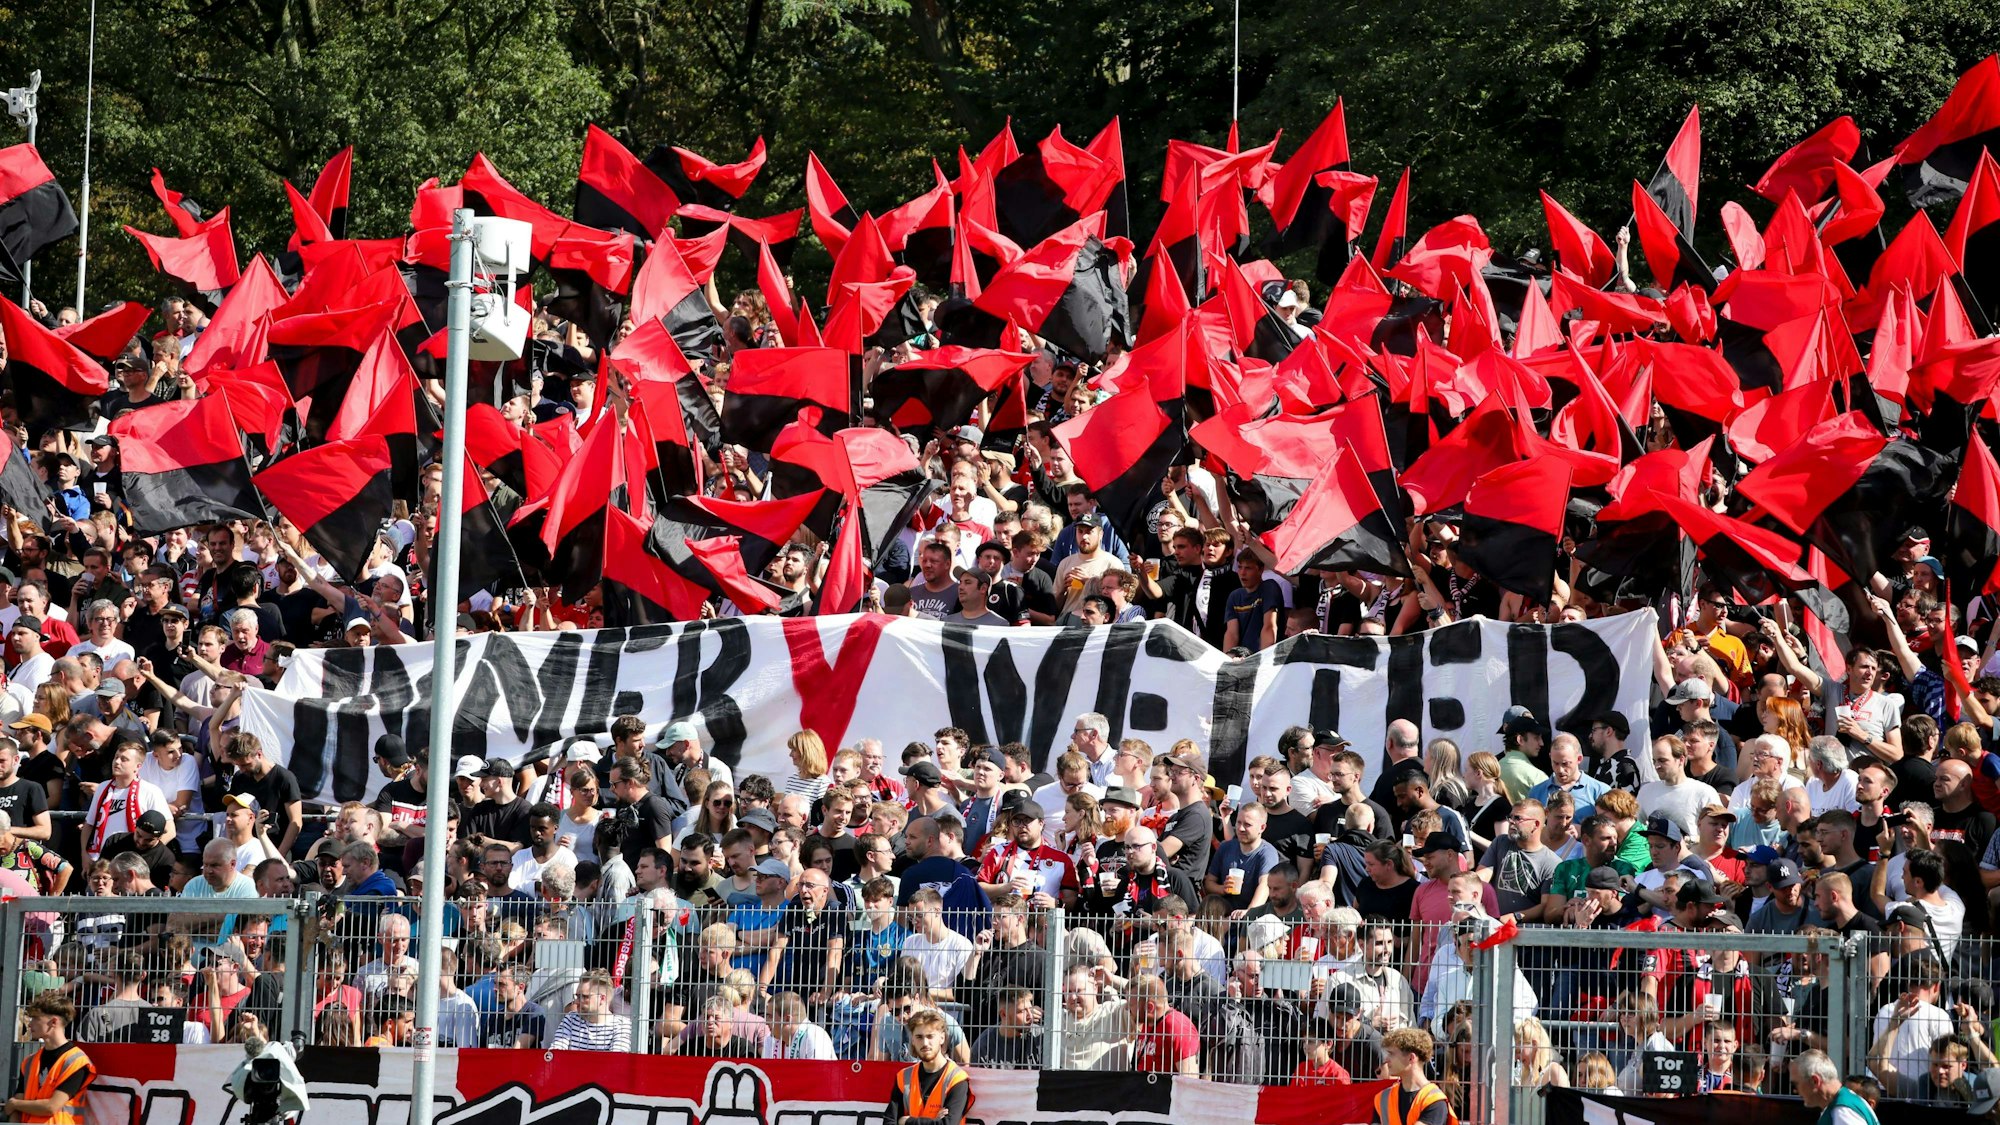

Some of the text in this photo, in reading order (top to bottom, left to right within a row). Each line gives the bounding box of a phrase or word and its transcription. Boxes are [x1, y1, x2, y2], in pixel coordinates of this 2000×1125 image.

[146, 1012, 174, 1043] Tor 38
[1654, 1056, 1683, 1090] Tor 39
